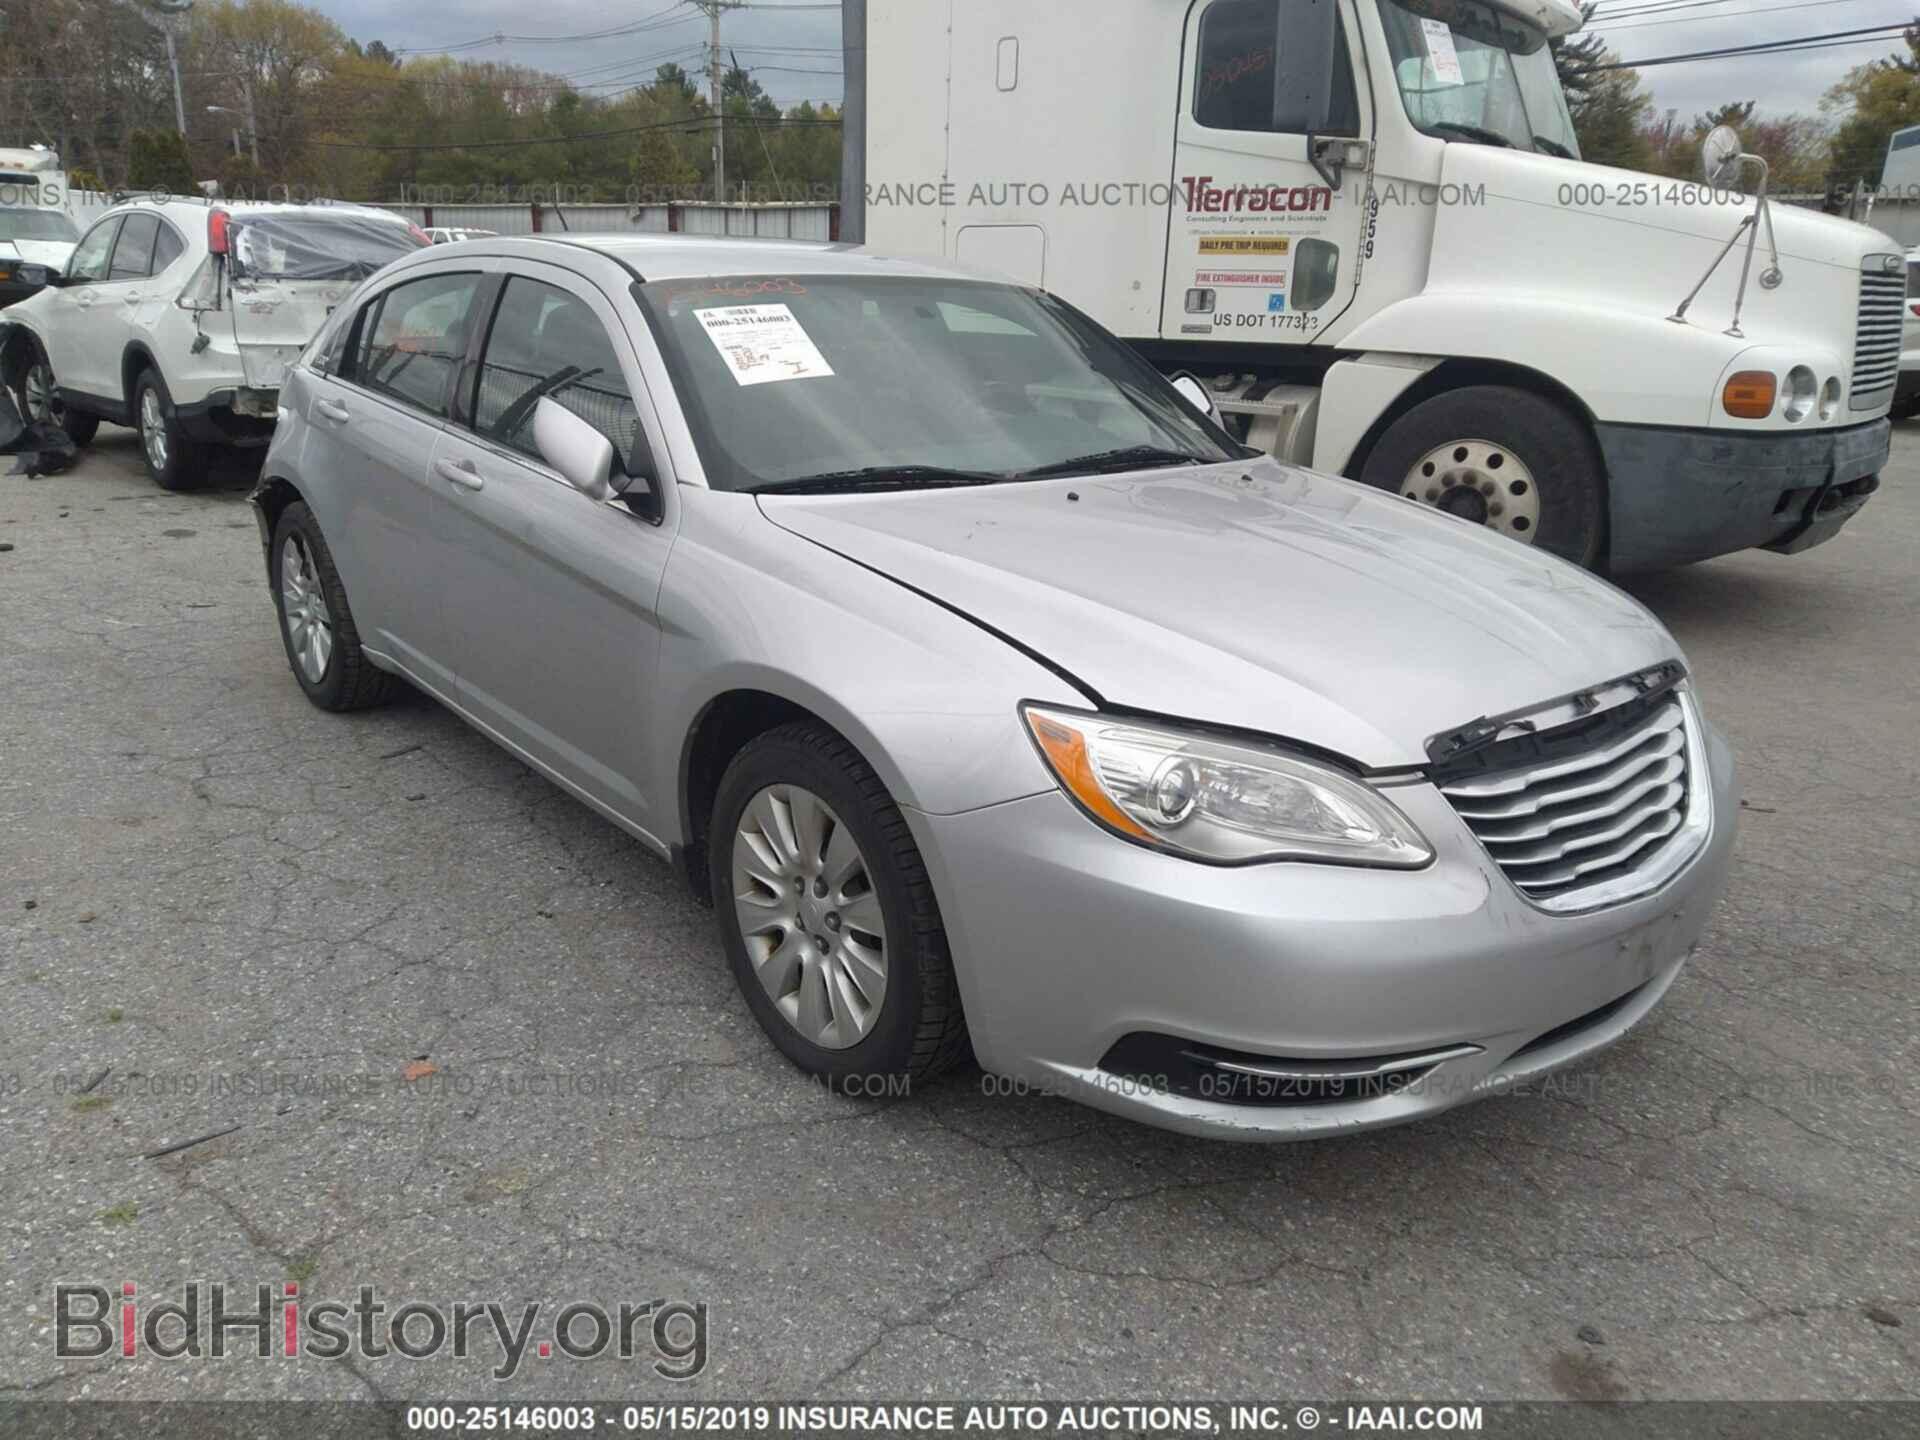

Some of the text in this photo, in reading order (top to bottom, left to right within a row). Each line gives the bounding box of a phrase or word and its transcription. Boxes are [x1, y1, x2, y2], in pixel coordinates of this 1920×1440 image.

[1182, 176, 1332, 213] Terracon
[1186, 214, 1327, 223] Consulting Engineers and Scientists
[1199, 239, 1288, 251] DAILY PRE TRIP REQUIRED
[1196, 273, 1285, 283] FIRE EXTINGUISHER INSIDE
[1213, 313, 1232, 327] US
[1236, 313, 1265, 327] DOT
